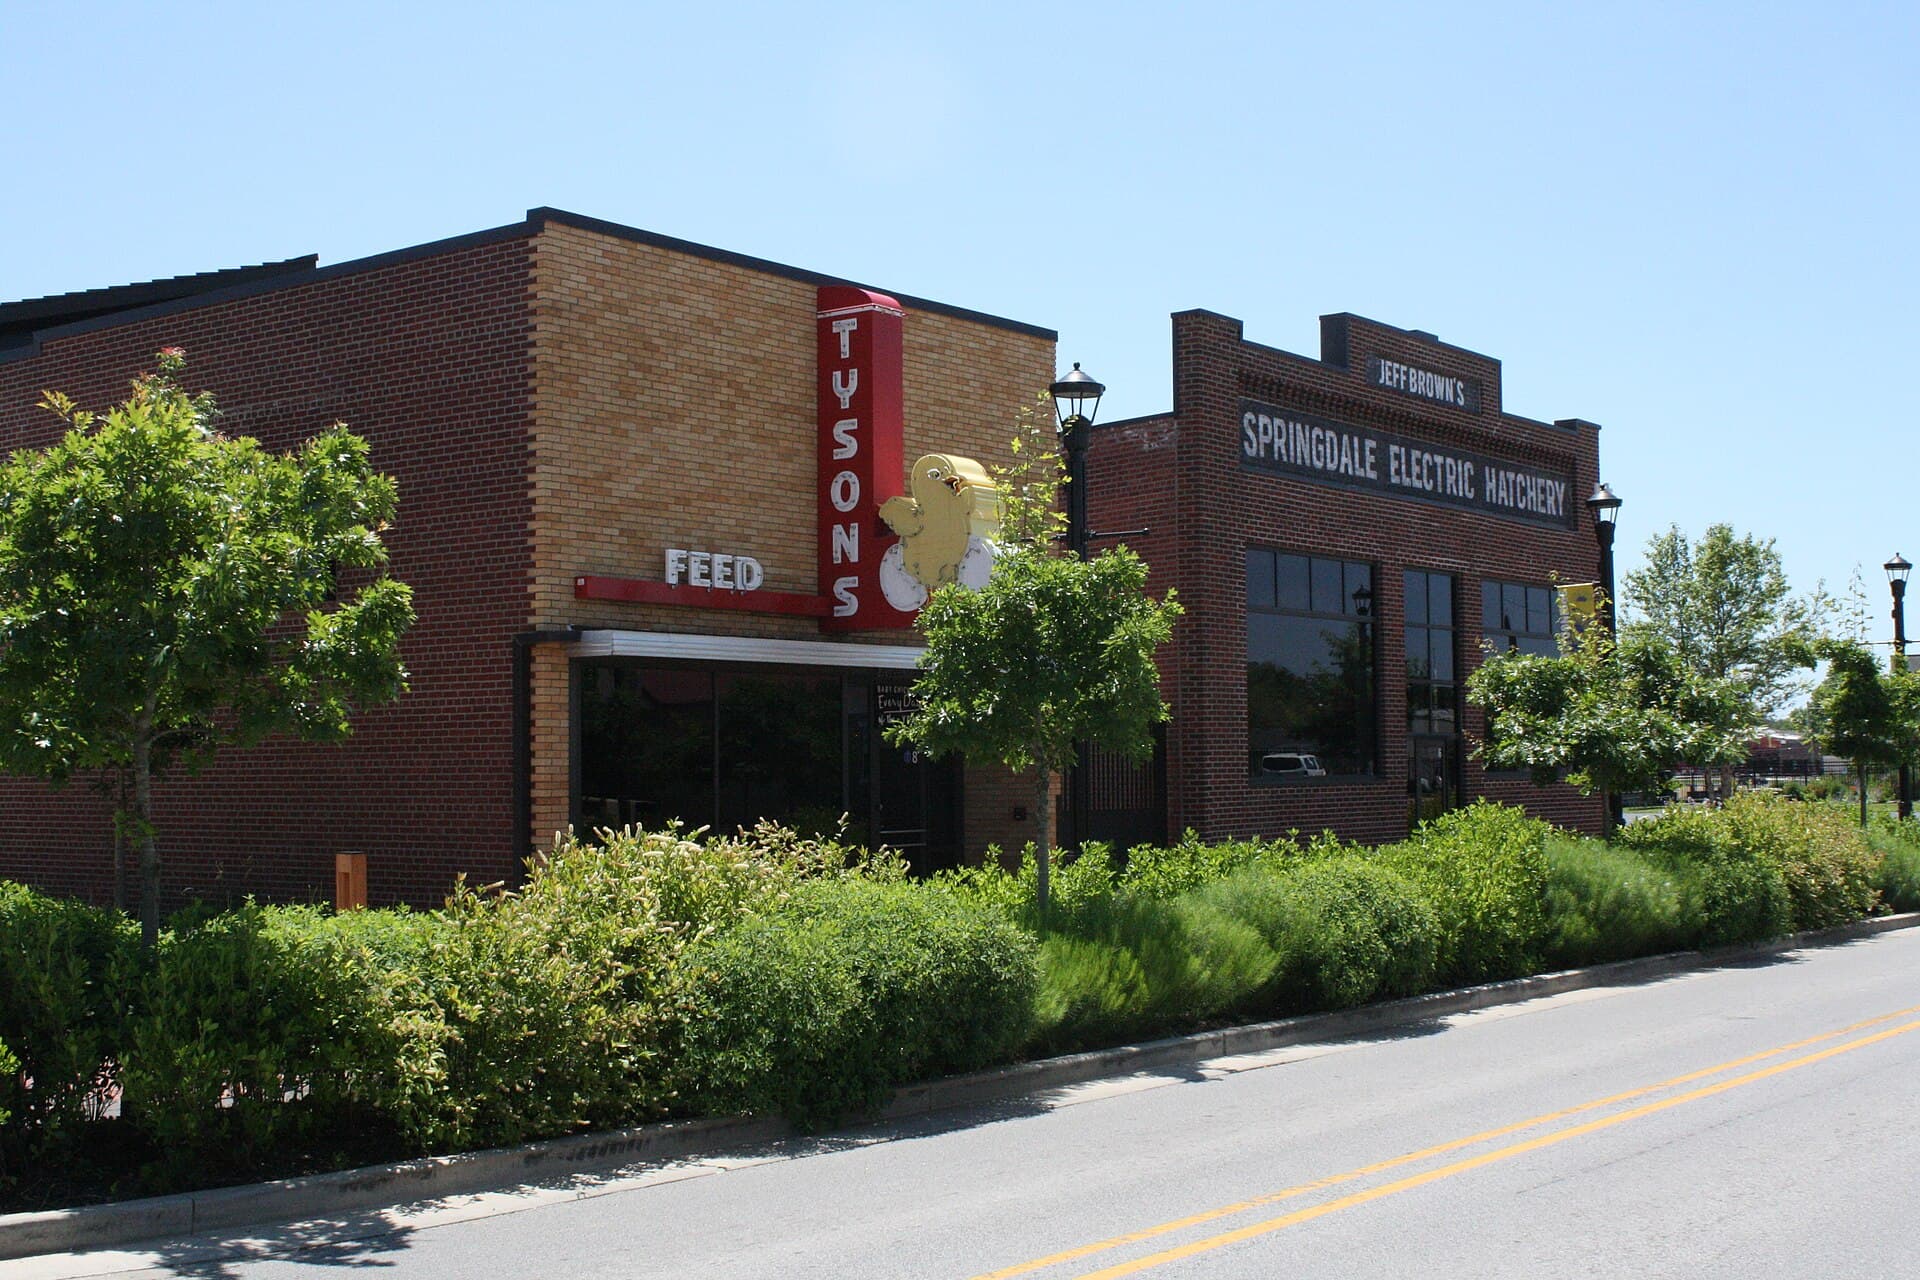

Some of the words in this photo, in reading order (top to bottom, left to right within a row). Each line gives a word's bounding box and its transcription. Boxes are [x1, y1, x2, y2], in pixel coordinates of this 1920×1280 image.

[1379, 359, 1407, 390] JEFF
[1408, 366, 1465, 406] BROWN'S
[830, 317, 861, 617] TYSONS
[1243, 411, 1378, 481] SPRINGDALE
[1389, 443, 1475, 499] ELECTRIC
[1485, 467, 1566, 517] HATCHERY
[665, 548, 764, 591] FEED
